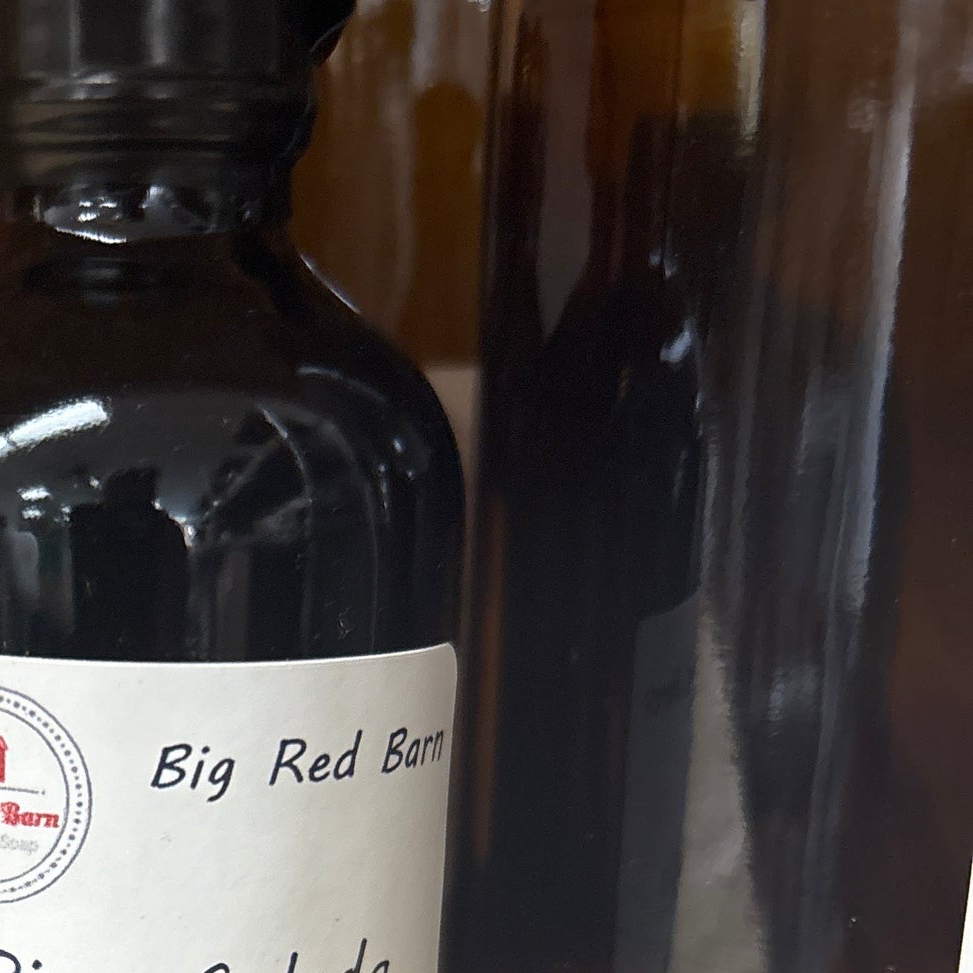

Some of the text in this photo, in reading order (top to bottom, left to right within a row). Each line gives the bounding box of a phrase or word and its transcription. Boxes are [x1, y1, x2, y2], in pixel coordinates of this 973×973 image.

[150, 726, 445, 802] Big Red Barn
[0, 801, 60, 829] Barn
[0, 834, 40, 855] Soap
